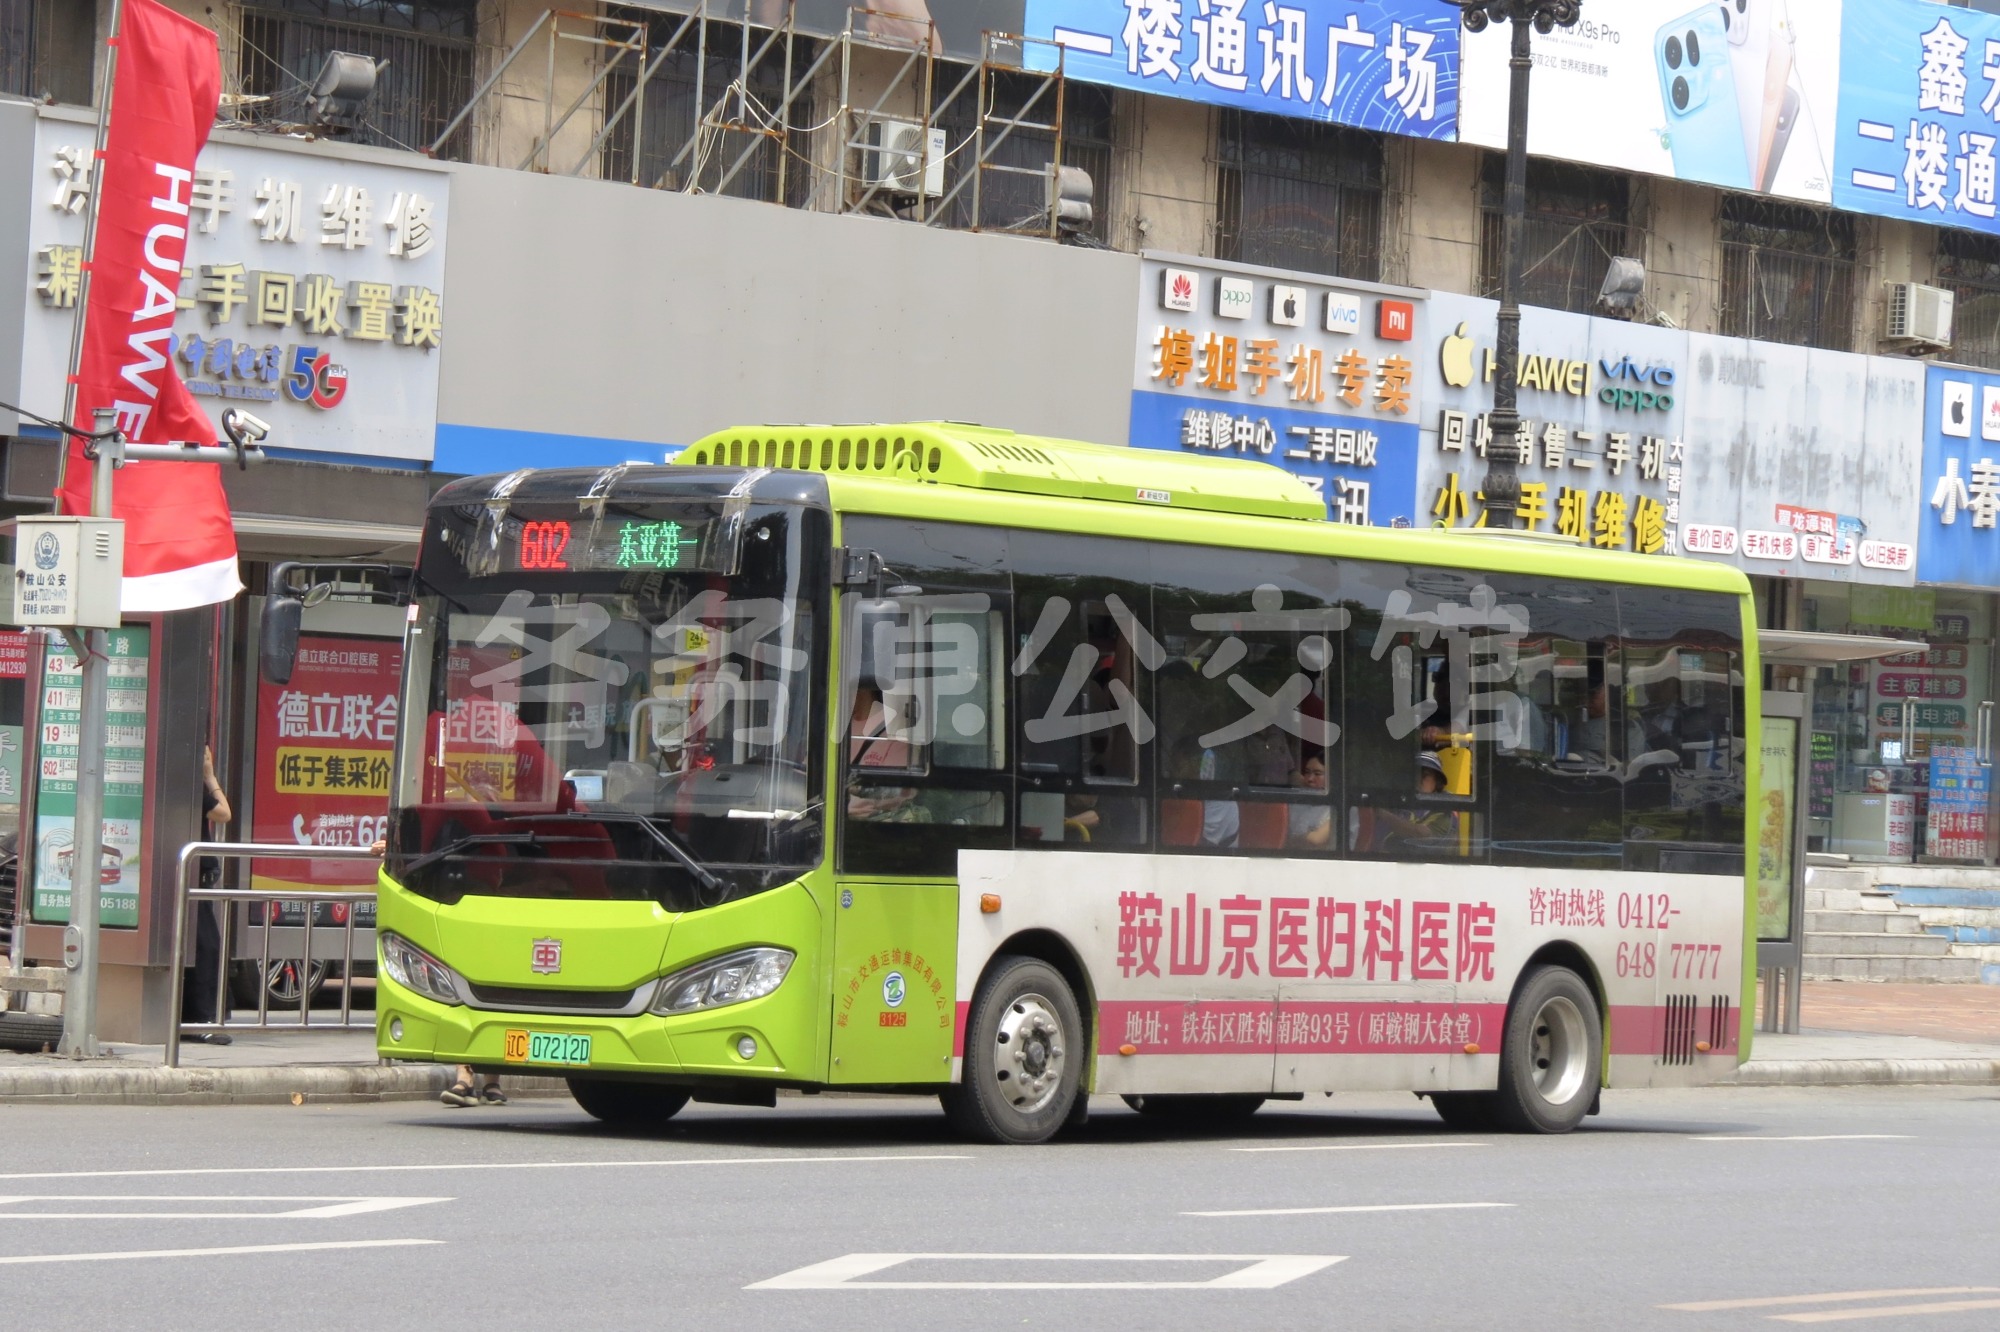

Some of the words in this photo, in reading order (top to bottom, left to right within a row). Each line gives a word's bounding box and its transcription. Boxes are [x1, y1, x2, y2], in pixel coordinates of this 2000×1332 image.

[1577, 20, 1598, 40] X9s
[1601, 23, 1620, 44] Pro
[53, 145, 436, 259] 洪手机维修
[37, 244, 442, 349] 精手回收置换
[1171, 299, 1191, 307] HUAWEI
[113, 162, 192, 463] HUAWE
[1331, 303, 1357, 324] vivo
[179, 333, 282, 383] 中国电信
[1152, 325, 1413, 415] 婷姐手机专卖
[1483, 347, 1593, 396] HAWEI
[1600, 355, 1676, 386] vivo
[283, 344, 348, 411] 5G
[1182, 408, 1277, 455] 维修中心
[1284, 426, 1379, 467] 二手回收
[1431, 473, 1667, 554] 小手机维修
[521, 521, 571, 569] 602
[616, 521, 698, 568] 东亚第一
[1688, 527, 1734, 549] 高价回收
[1747, 534, 1793, 557] 手机快修
[1865, 544, 1908, 567] 以旧换新
[26, 573, 67, 587] 鞍山公安
[48, 658, 63, 673] 43
[299, 650, 379, 667] 德立联合口腔医院
[47, 690, 63, 706] 411
[1883, 678, 1961, 695] 主板维修
[277, 690, 398, 741] 德立联合
[45, 726, 60, 742] 19
[43, 760, 58, 776] 602
[279, 754, 391, 790] 低于集采价
[319, 814, 355, 828] 咨询热线
[318, 829, 353, 847] 0412
[1528, 886, 1606, 928] 咨询热线
[1618, 891, 1681, 930] 0412-
[1117, 890, 1496, 983] 鞍山京医妇科医院
[1616, 941, 1657, 979] 648
[1670, 943, 1722, 980] 7777
[837, 948, 950, 1029] 鞍山市交通运输集团有限公司
[880, 1012, 906, 1027] 3125
[507, 1033, 526, 1058] 辽C
[532, 1035, 590, 1062] 07212D
